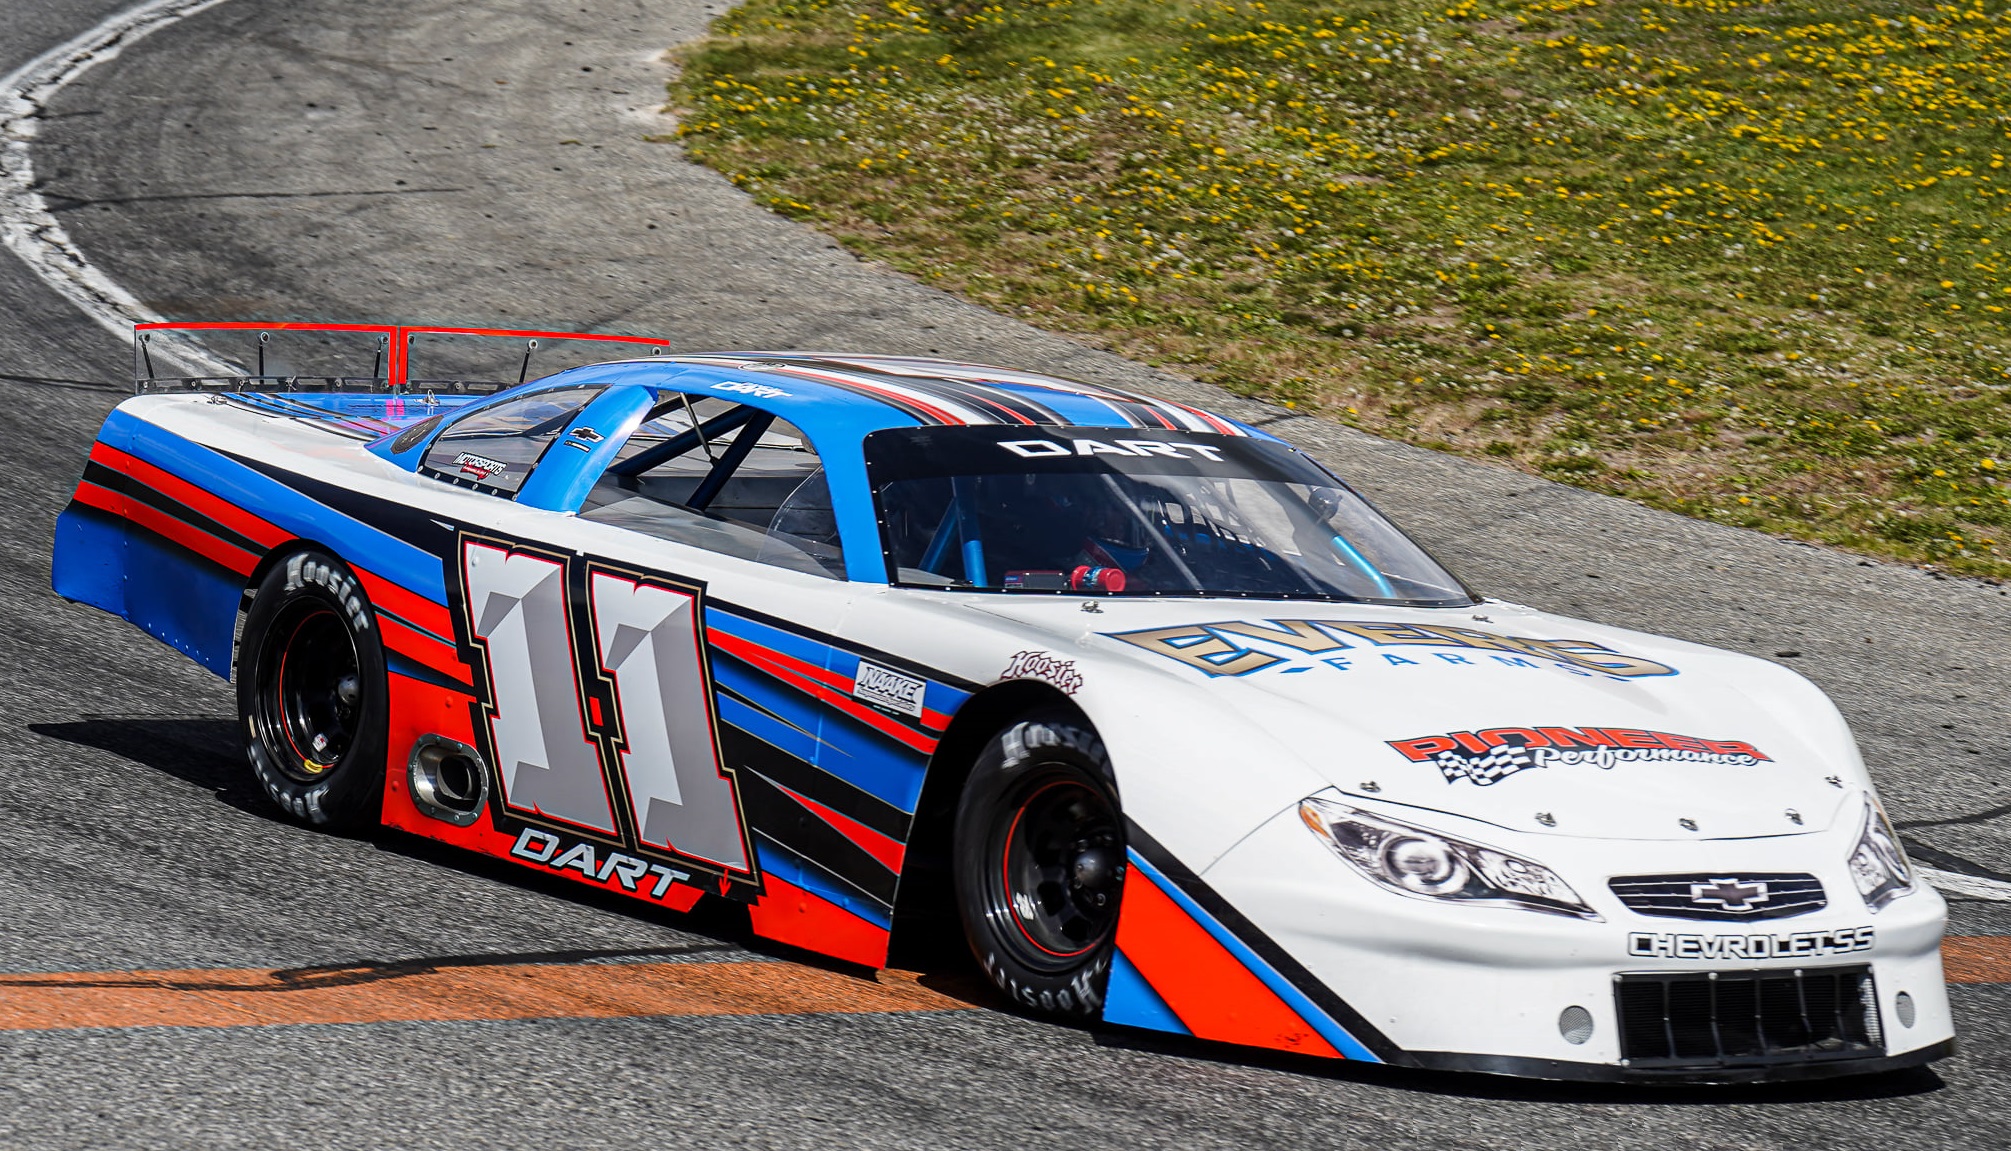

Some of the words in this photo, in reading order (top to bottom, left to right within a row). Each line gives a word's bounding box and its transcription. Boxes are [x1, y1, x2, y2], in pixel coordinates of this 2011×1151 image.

[709, 381, 793, 398] DART
[452, 452, 507, 476] MOTORSPORTS
[996, 439, 1225, 462] DART
[283, 553, 370, 633] Hoosier
[1093, 619, 1681, 678] EVERS
[1319, 652, 1592, 677] FARMS
[857, 667, 924, 704] NAAKE
[1000, 651, 1083, 695] Hoosier
[462, 539, 752, 876] 11
[1385, 726, 1775, 763] PIONEER
[1526, 745, 1761, 770] Performance
[510, 826, 692, 898] DART
